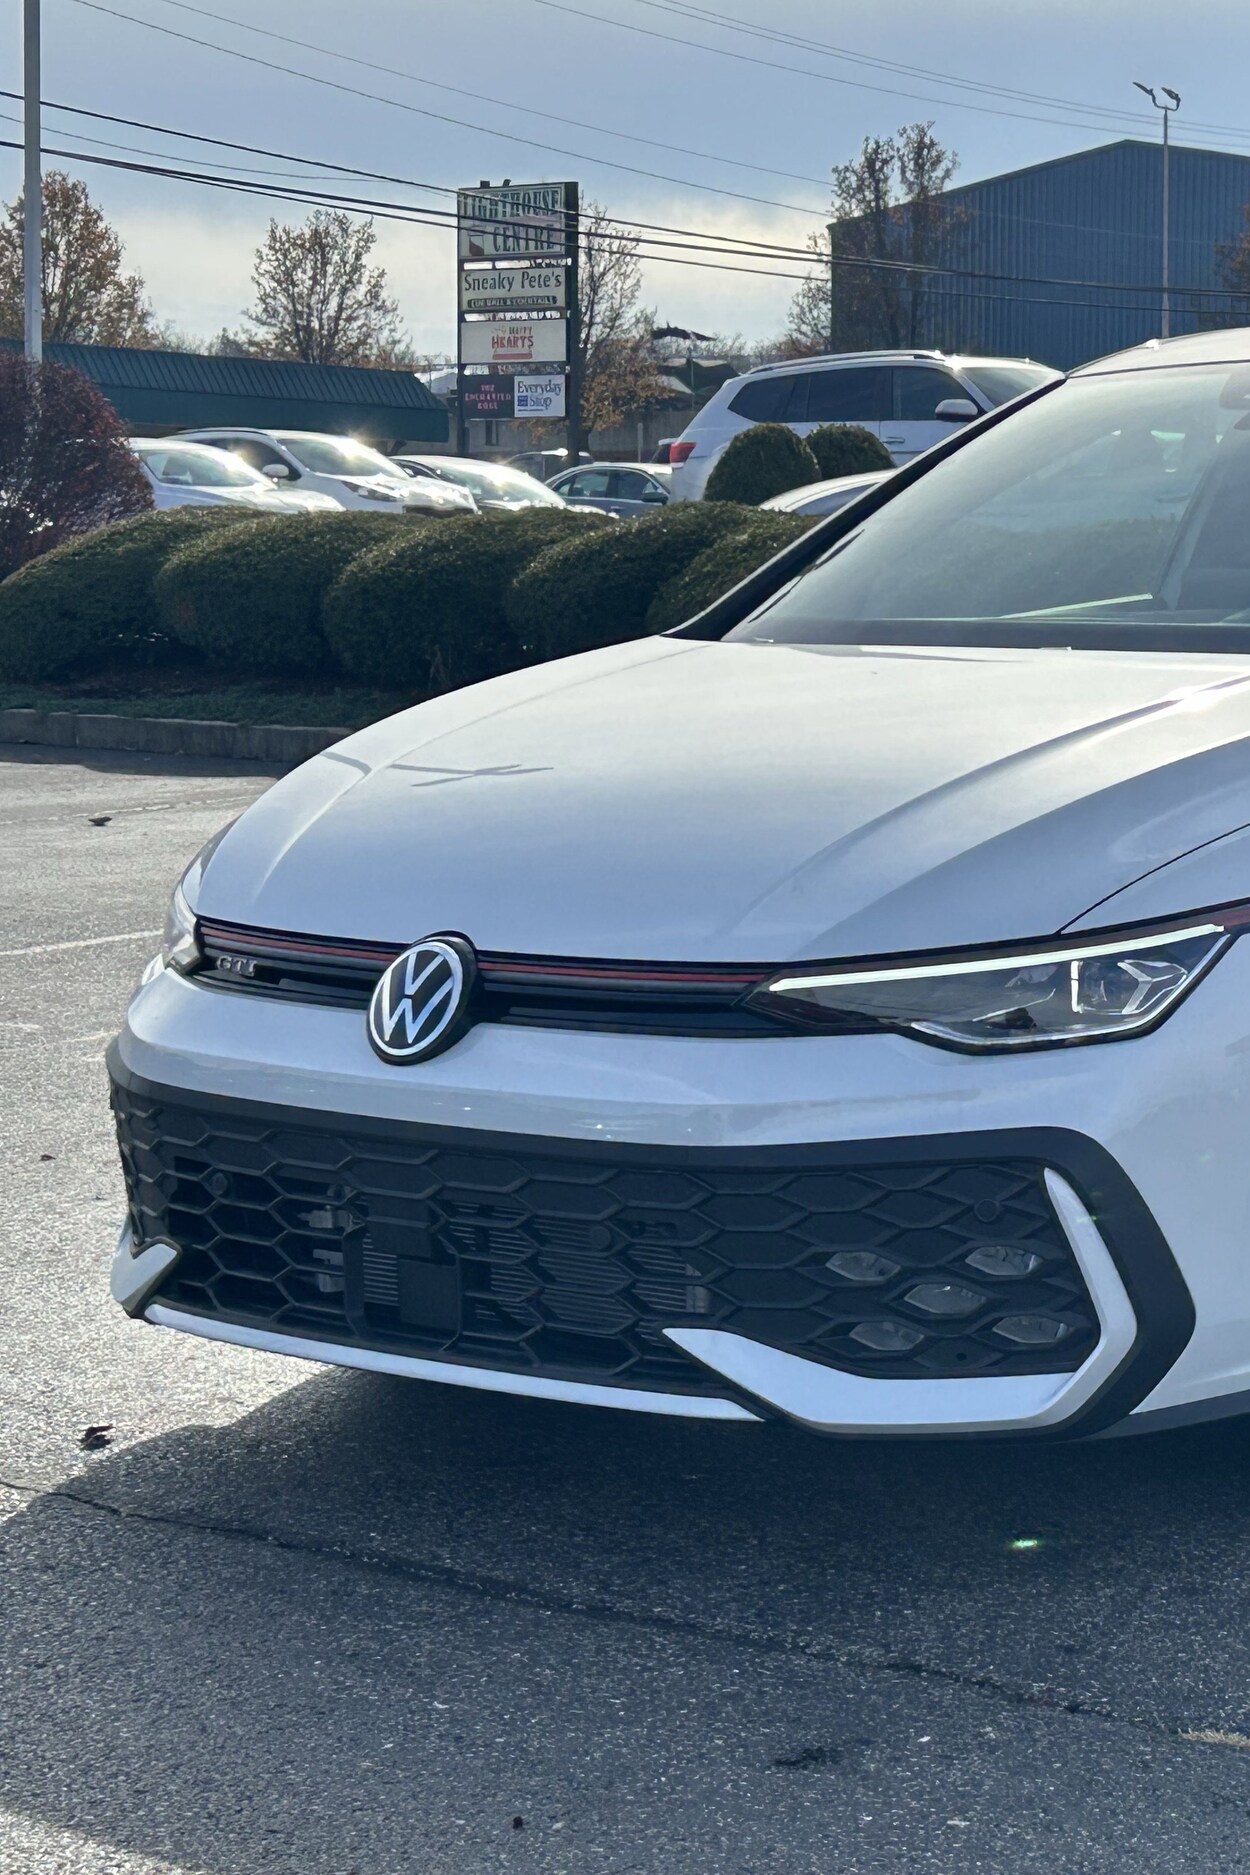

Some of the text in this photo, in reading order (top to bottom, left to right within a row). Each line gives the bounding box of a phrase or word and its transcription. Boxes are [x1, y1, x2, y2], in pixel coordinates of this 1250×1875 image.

[493, 224, 555, 252] CENTRE
[464, 271, 562, 292] Sneaky Pete's
[491, 335, 534, 349] HEARTS
[517, 379, 562, 396] Everyday
[215, 955, 259, 978] GTI
